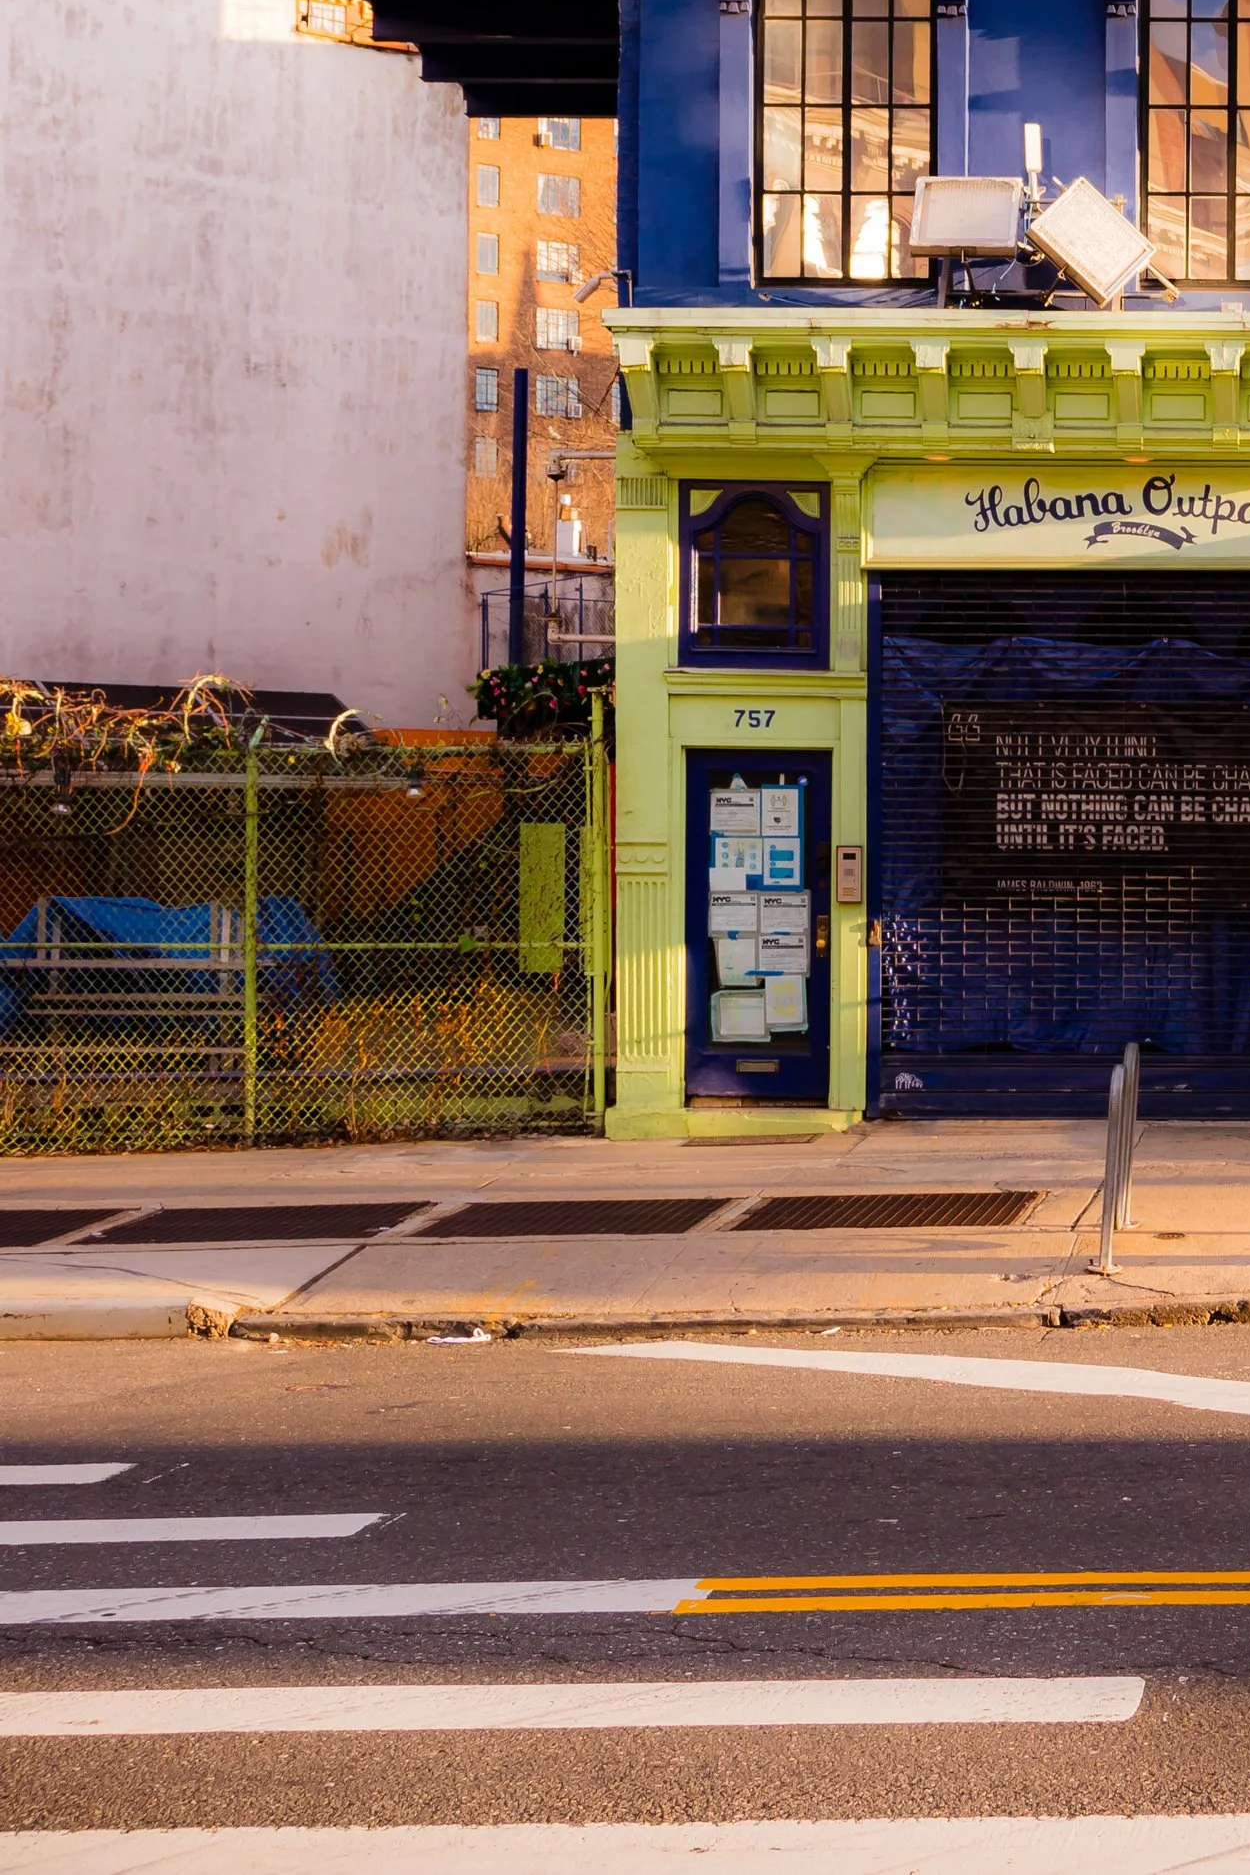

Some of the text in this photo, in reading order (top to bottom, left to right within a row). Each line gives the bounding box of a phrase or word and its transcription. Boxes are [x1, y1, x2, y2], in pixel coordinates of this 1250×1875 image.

[965, 477, 1134, 532] Habana
[1111, 521, 1161, 538] Brooklyn
[734, 709, 777, 728] 757
[996, 761, 1046, 788] THAT
[1051, 761, 1067, 789] IS
[1072, 761, 1132, 789] FACED
[1138, 762, 1178, 790] CAN
[1183, 763, 1207, 791] BE
[996, 794, 1036, 820] BUT
[1041, 794, 1128, 821] NOTHING
[1134, 795, 1174, 821] CAN
[1181, 796, 1206, 822] BE
[996, 824, 1053, 851] UNTIL
